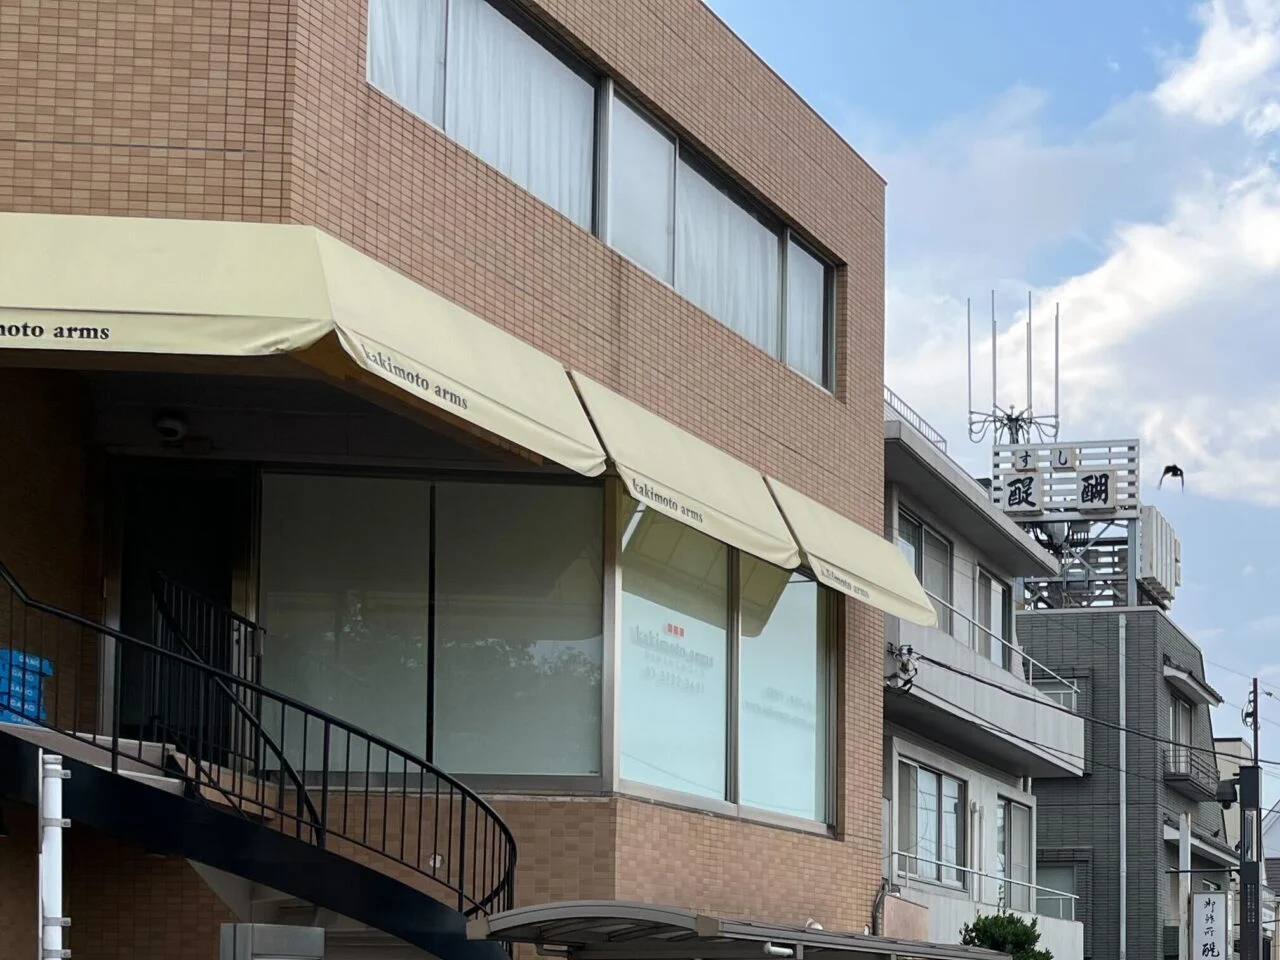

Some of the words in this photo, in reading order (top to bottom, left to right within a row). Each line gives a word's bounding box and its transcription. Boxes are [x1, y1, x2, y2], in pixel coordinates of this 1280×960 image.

[53, 326, 110, 340] arms
[361, 344, 430, 391] kakimoto
[434, 385, 468, 410] arms
[632, 478, 678, 512] kakimoto
[680, 505, 703, 523] arms
